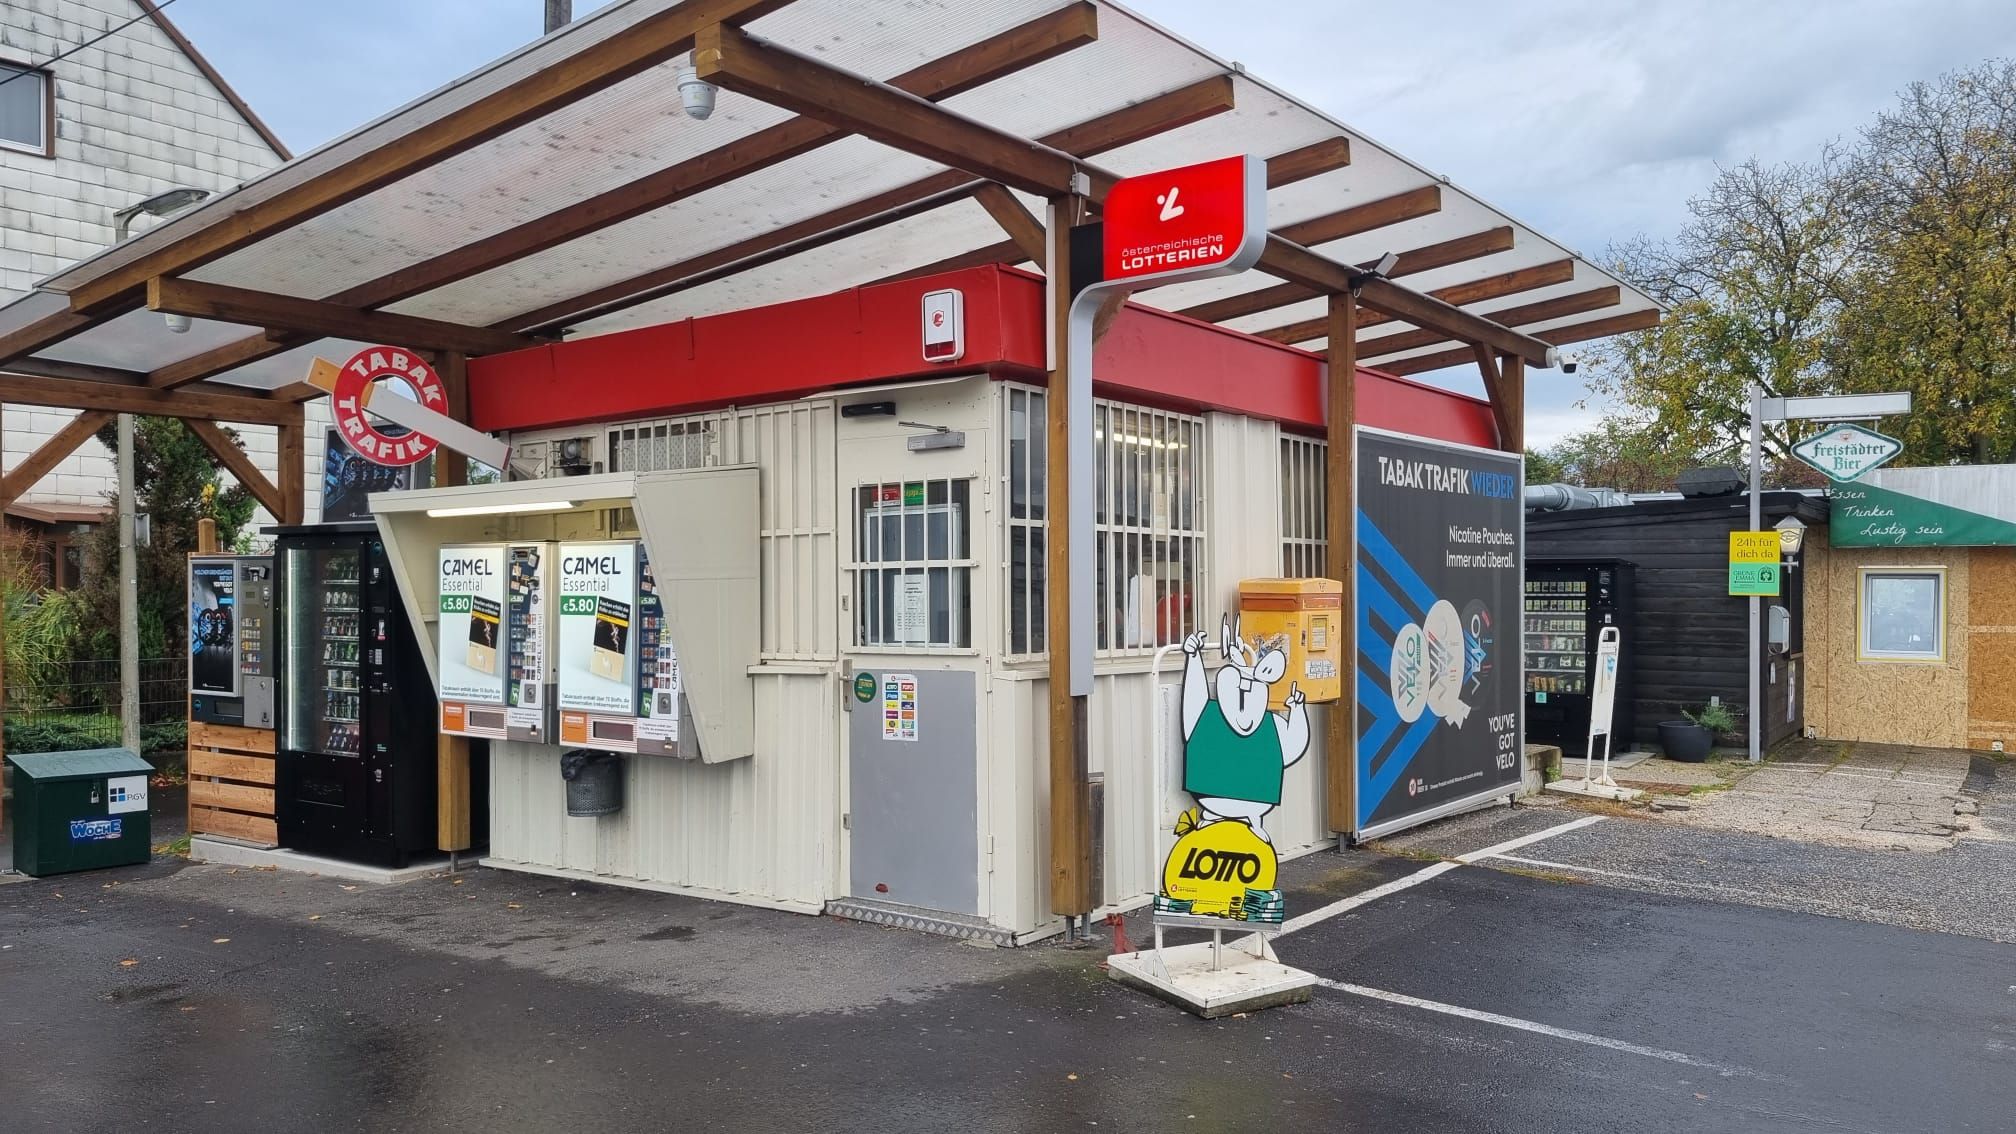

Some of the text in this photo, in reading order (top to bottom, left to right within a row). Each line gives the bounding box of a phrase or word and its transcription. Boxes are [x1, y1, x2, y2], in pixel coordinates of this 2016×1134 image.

[1121, 234, 1224, 257] österreichische
[1121, 243, 1224, 270] LOTTERIEN
[351, 352, 442, 402] TABAK
[339, 396, 428, 459] TRAFIK
[1833, 456, 1862, 471] Bier
[1378, 456, 1514, 499] TABAK TRAFIK WIEDER
[1830, 488, 1866, 500] Essen
[1843, 504, 1895, 518] Trinken
[1449, 525, 1515, 545] Nicotine Pouches.
[1736, 537, 1756, 547] 24h
[1860, 521, 1944, 545] Lustig sein
[1446, 549, 1515, 568] Immer und überall.
[1736, 549, 1774, 558] dich da
[442, 559, 493, 576] CAMEL
[562, 556, 621, 575] CAMEL
[442, 577, 483, 591] Essential
[563, 577, 609, 592] Essential
[442, 597, 470, 610] €5.80
[562, 598, 594, 612] €5.80
[1488, 712, 1515, 733] YOU'VE
[1498, 732, 1515, 750] GOT
[1496, 751, 1515, 771] VELO
[70, 819, 121, 838] WOCHE
[1178, 847, 1261, 884] LOTTO
